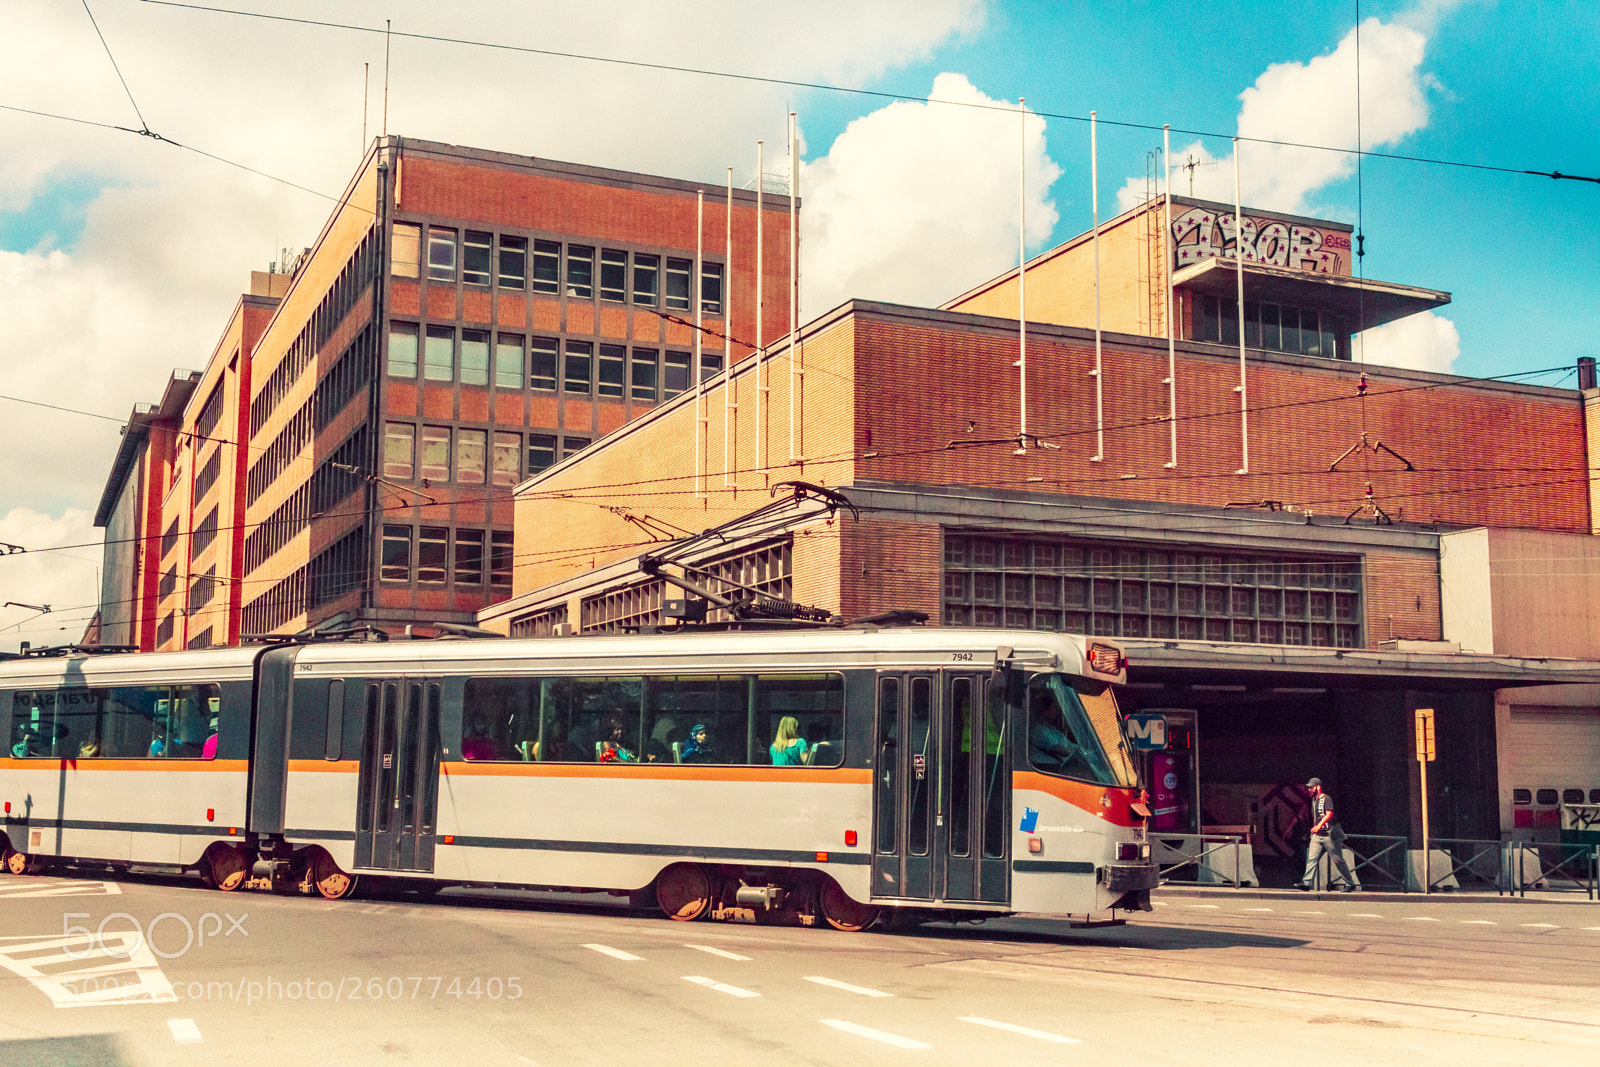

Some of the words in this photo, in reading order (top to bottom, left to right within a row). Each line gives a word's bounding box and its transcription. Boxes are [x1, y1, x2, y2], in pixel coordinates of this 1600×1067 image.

[952, 653, 973, 661] 7942
[299, 664, 313, 672] 7942
[1127, 719, 1165, 744] M
